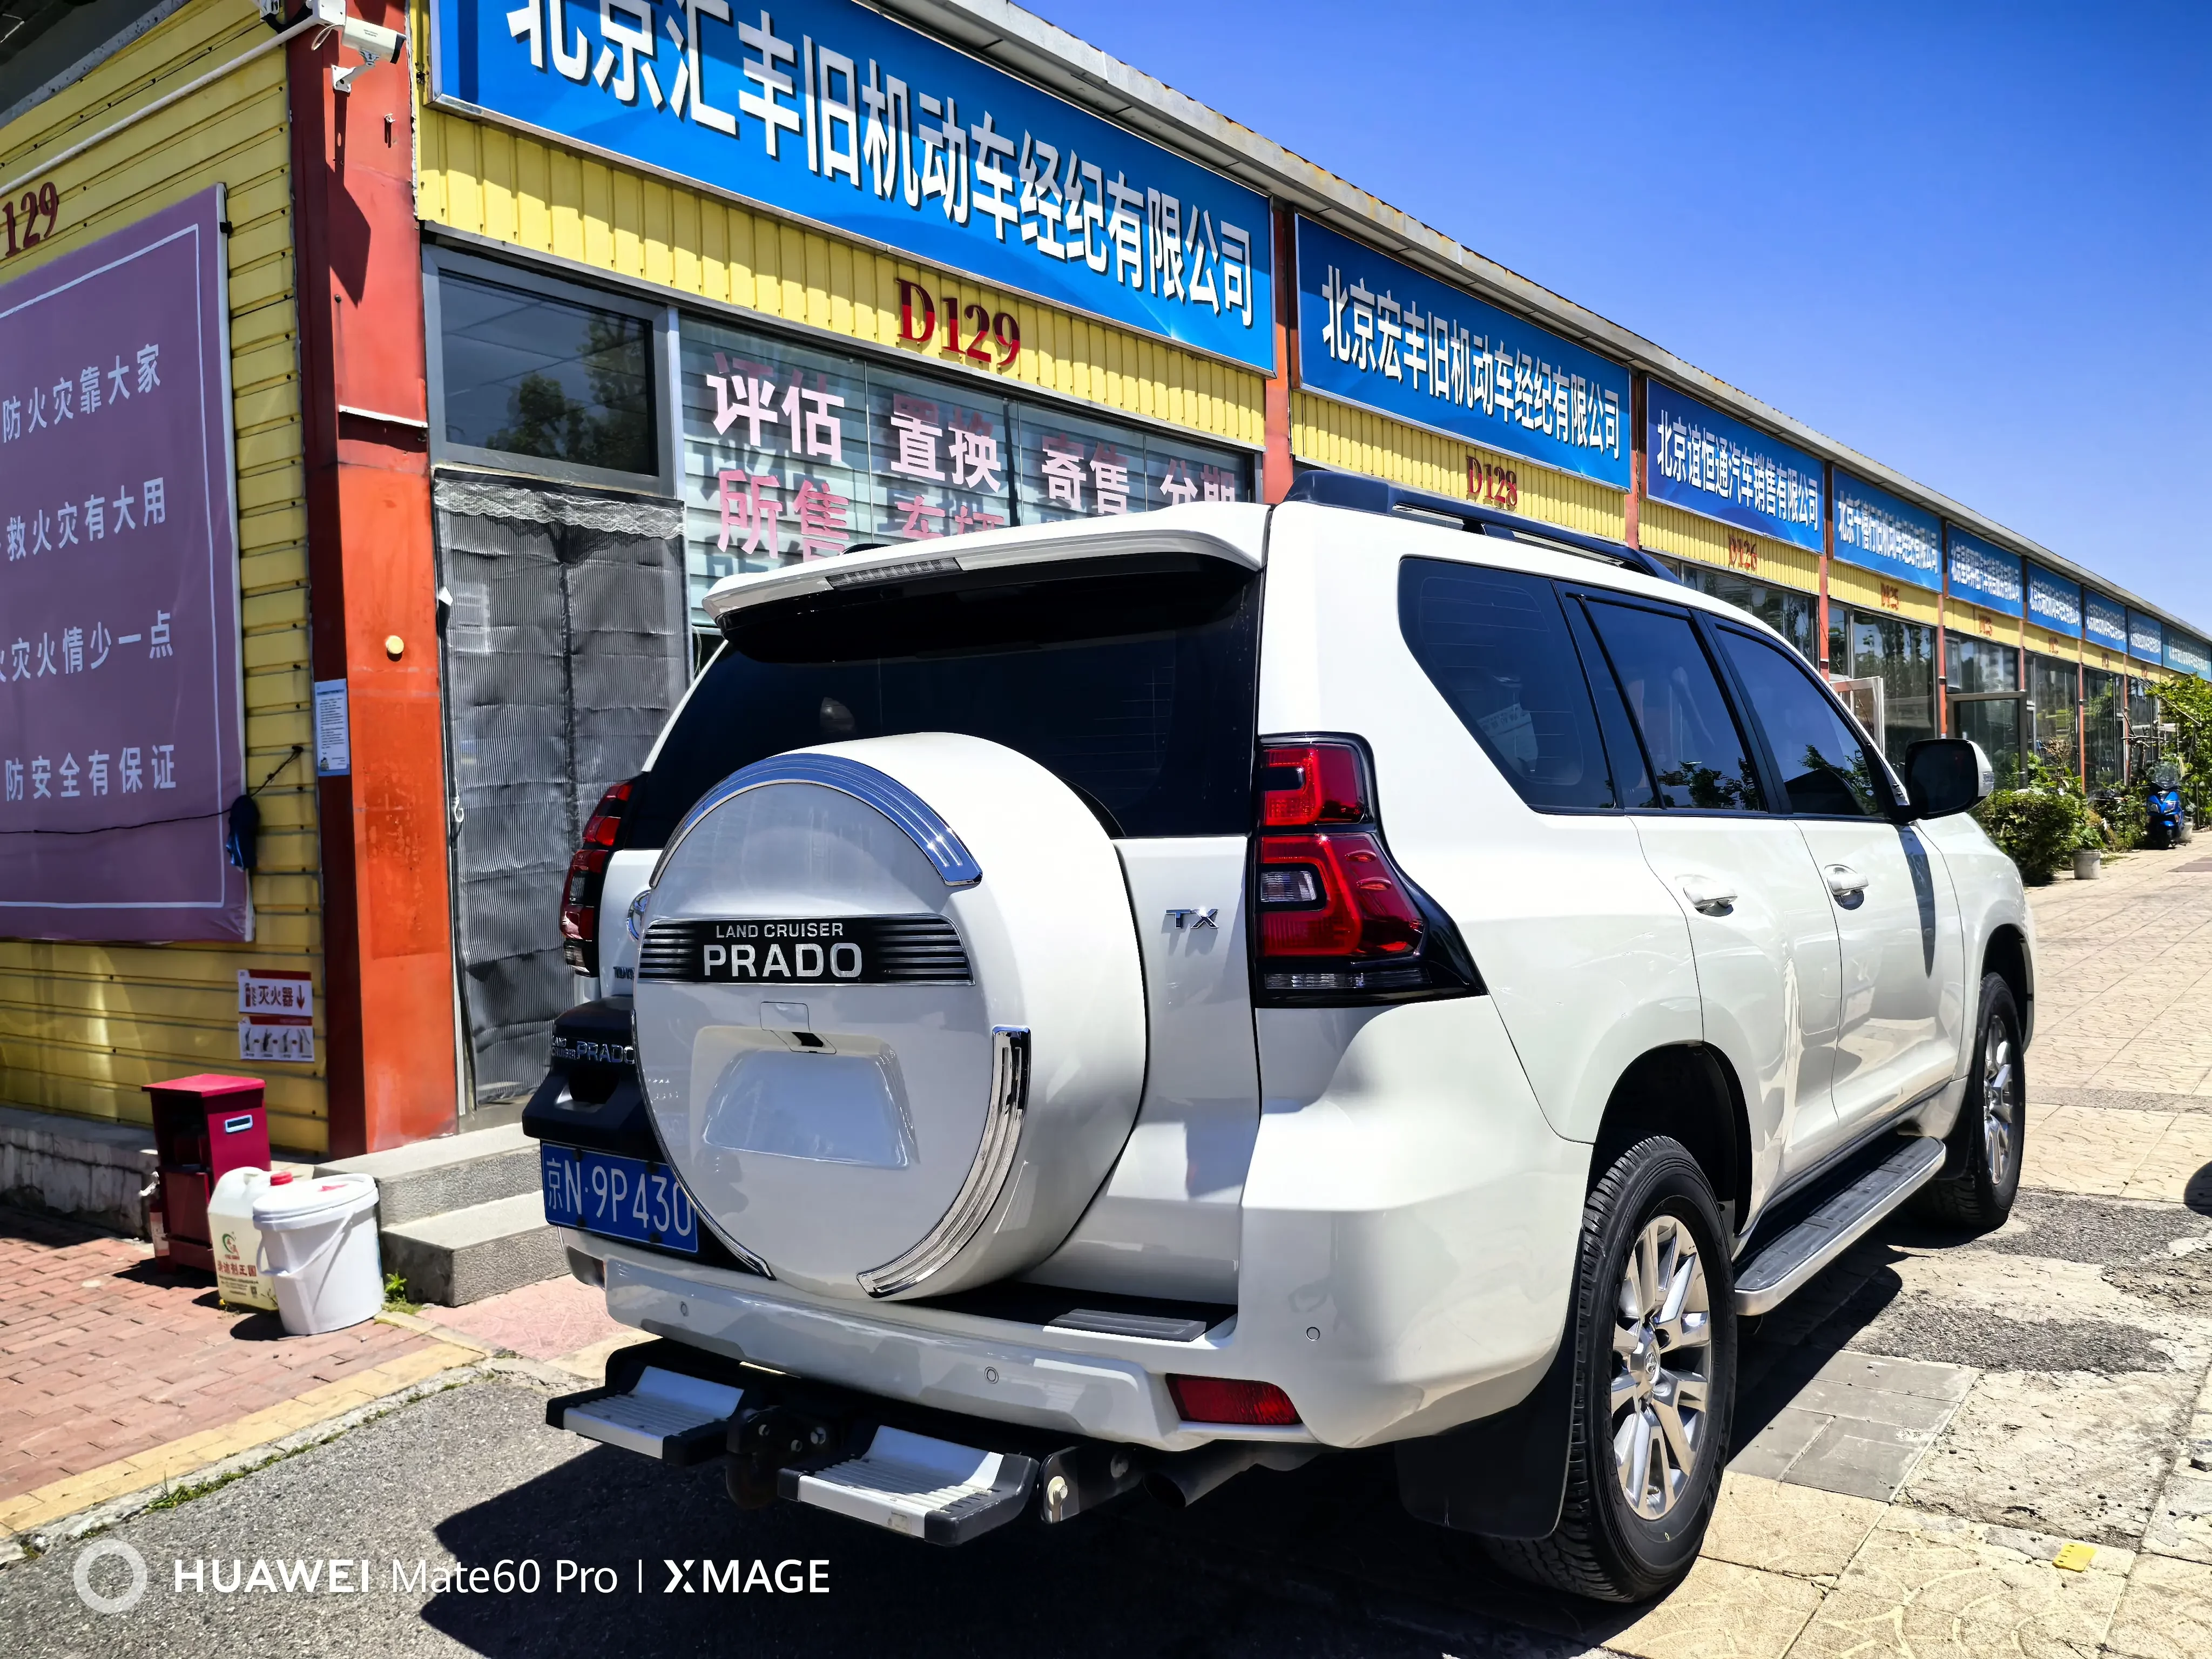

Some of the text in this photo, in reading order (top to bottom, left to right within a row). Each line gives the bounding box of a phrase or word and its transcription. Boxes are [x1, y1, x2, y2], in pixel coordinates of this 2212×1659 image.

[2, 181, 59, 258] 129
[896, 278, 1021, 368] D129
[3, 343, 161, 443] 防火灾靠大家
[1321, 265, 1620, 459] 北京宏丰旧机动车经纪有限公司
[706, 353, 845, 462] 评估
[890, 393, 1001, 493] 置换
[1041, 433, 1130, 515] 寄售
[1466, 456, 1518, 506] D128
[6, 477, 166, 562] 救火灾有大用
[718, 469, 849, 562] 所售
[5, 745, 177, 801] 防安全有保证
[716, 922, 844, 939] LAND CRUISER
[1165, 908, 1219, 929] TX
[703, 942, 862, 978] PRADO
[258, 985, 294, 1007] 灭火器
[576, 1041, 636, 1065] PRADO
